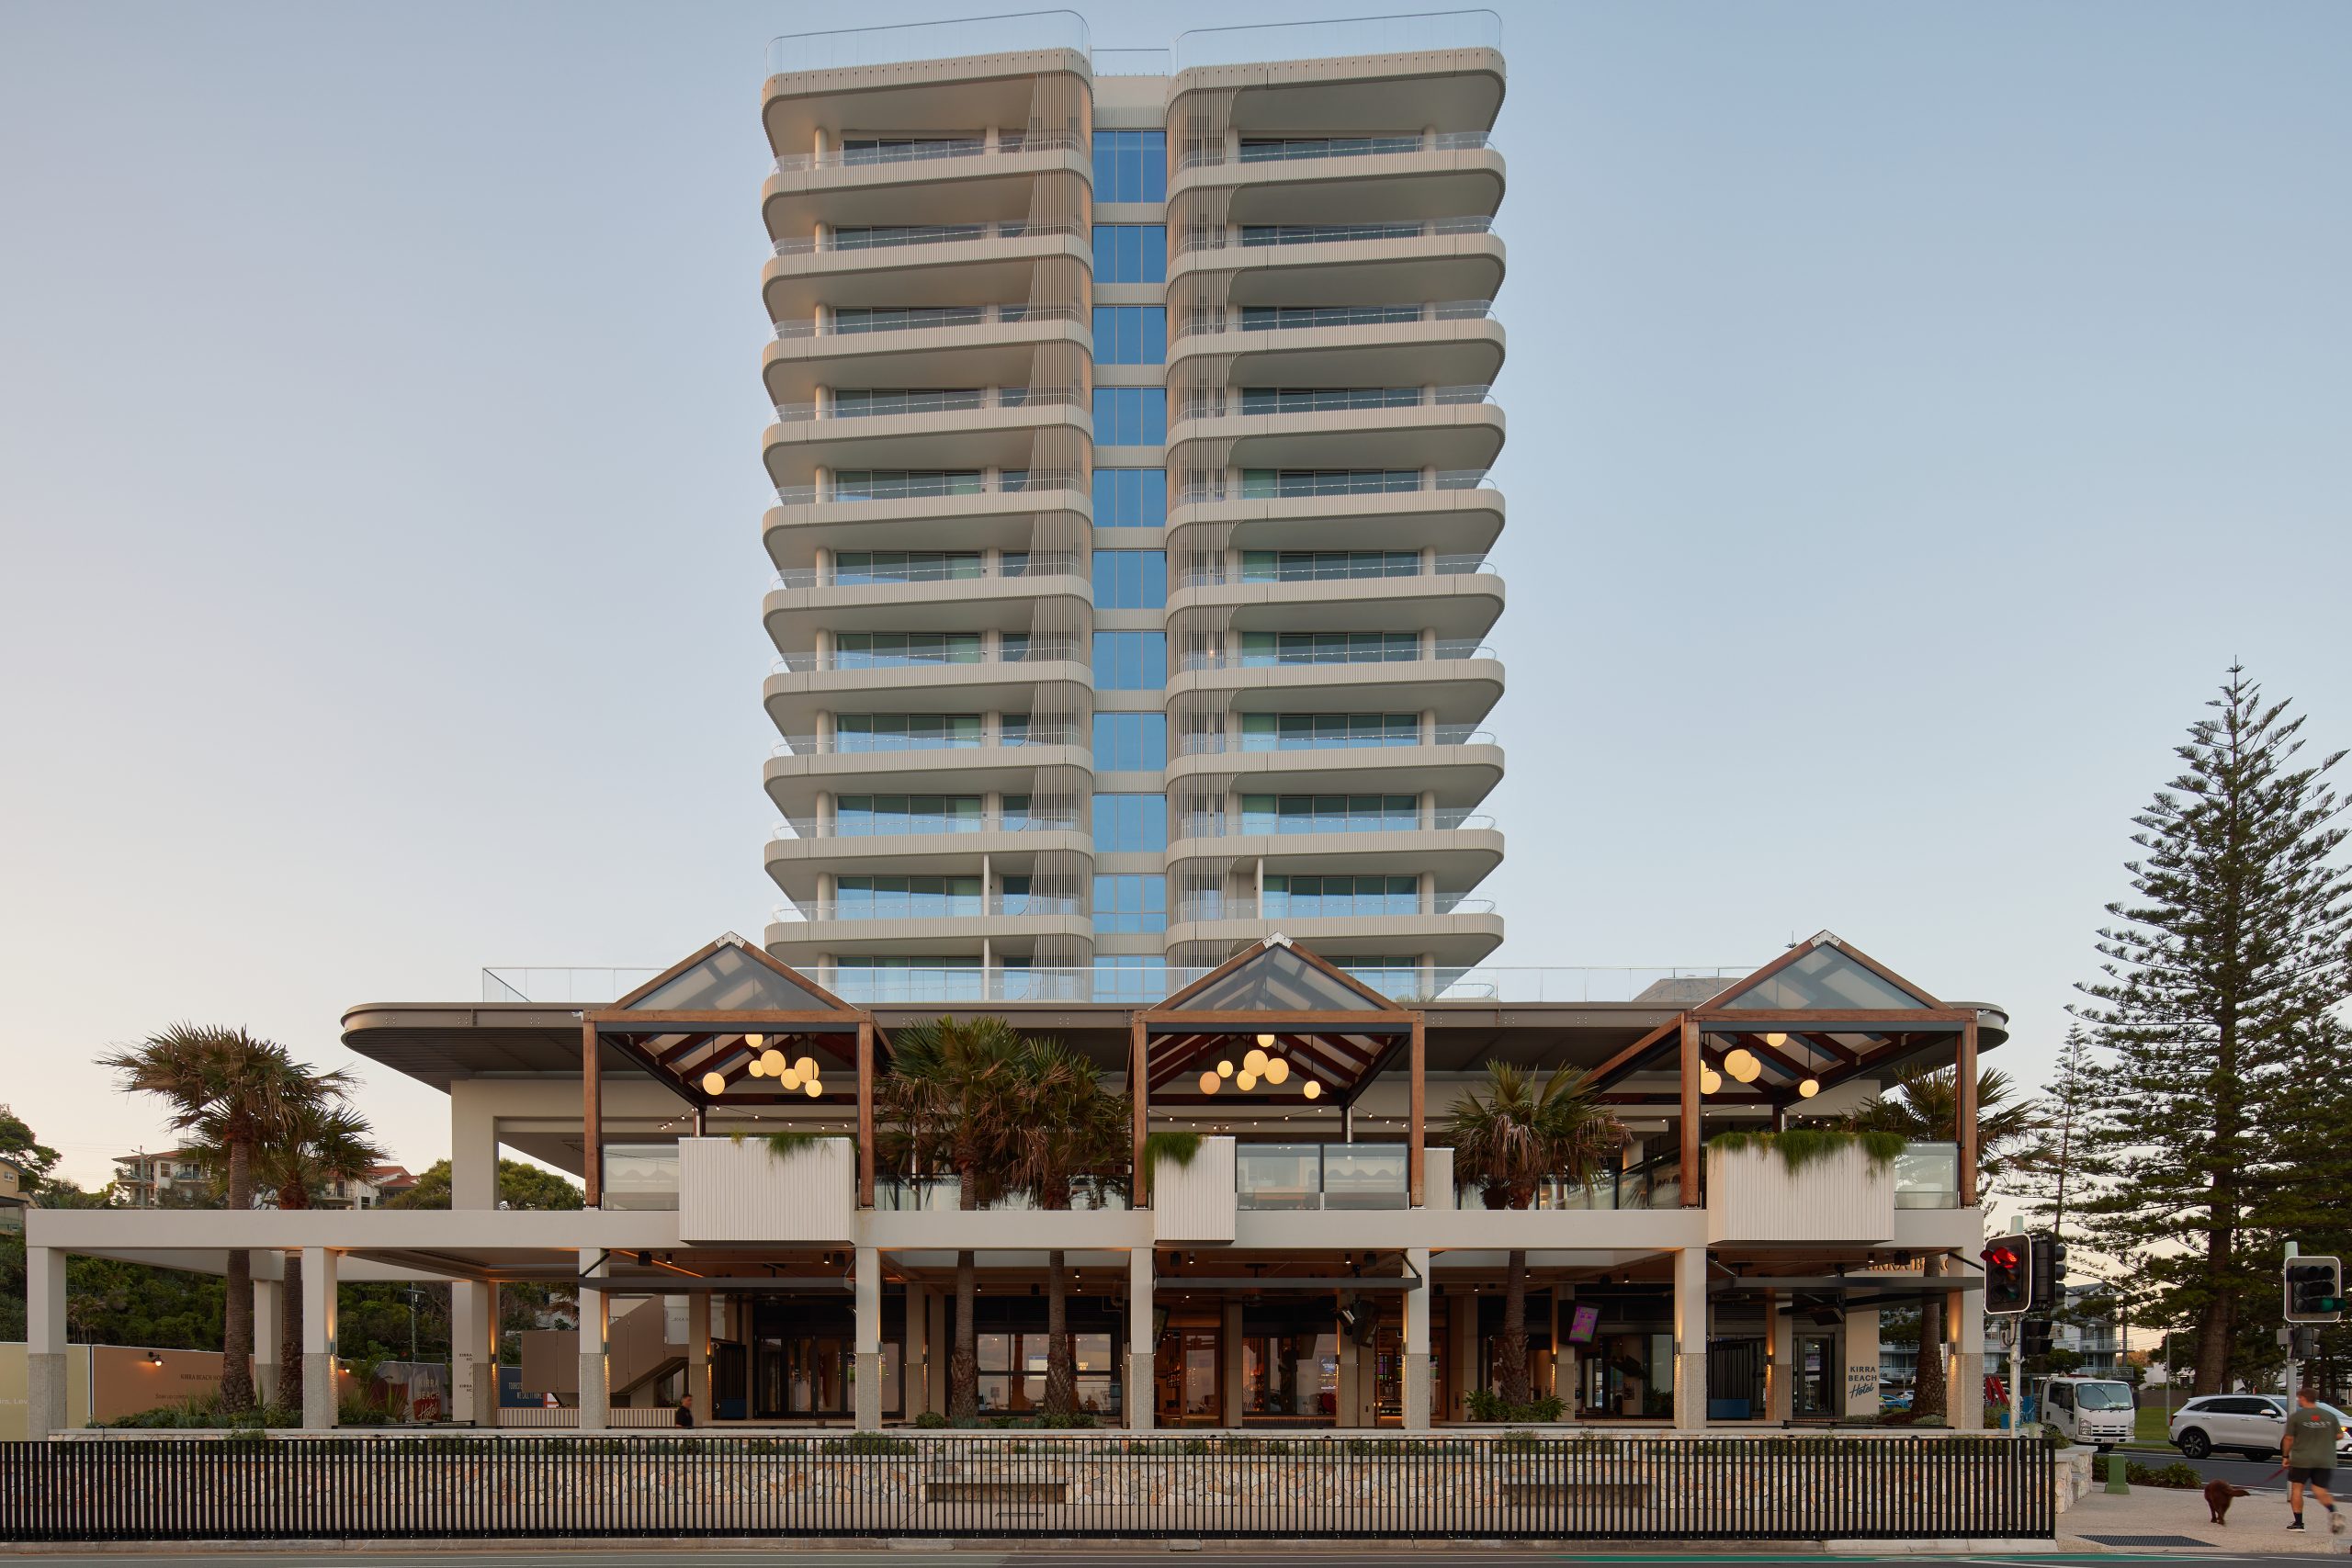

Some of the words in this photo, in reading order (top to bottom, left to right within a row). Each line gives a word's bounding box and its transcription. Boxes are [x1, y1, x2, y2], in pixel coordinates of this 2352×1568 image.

[418, 1379, 439, 1388] KIRRA
[417, 1391, 440, 1400] BEACH
[1849, 1382, 1874, 1399] Hotel
[418, 1402, 438, 1420] Hotel
